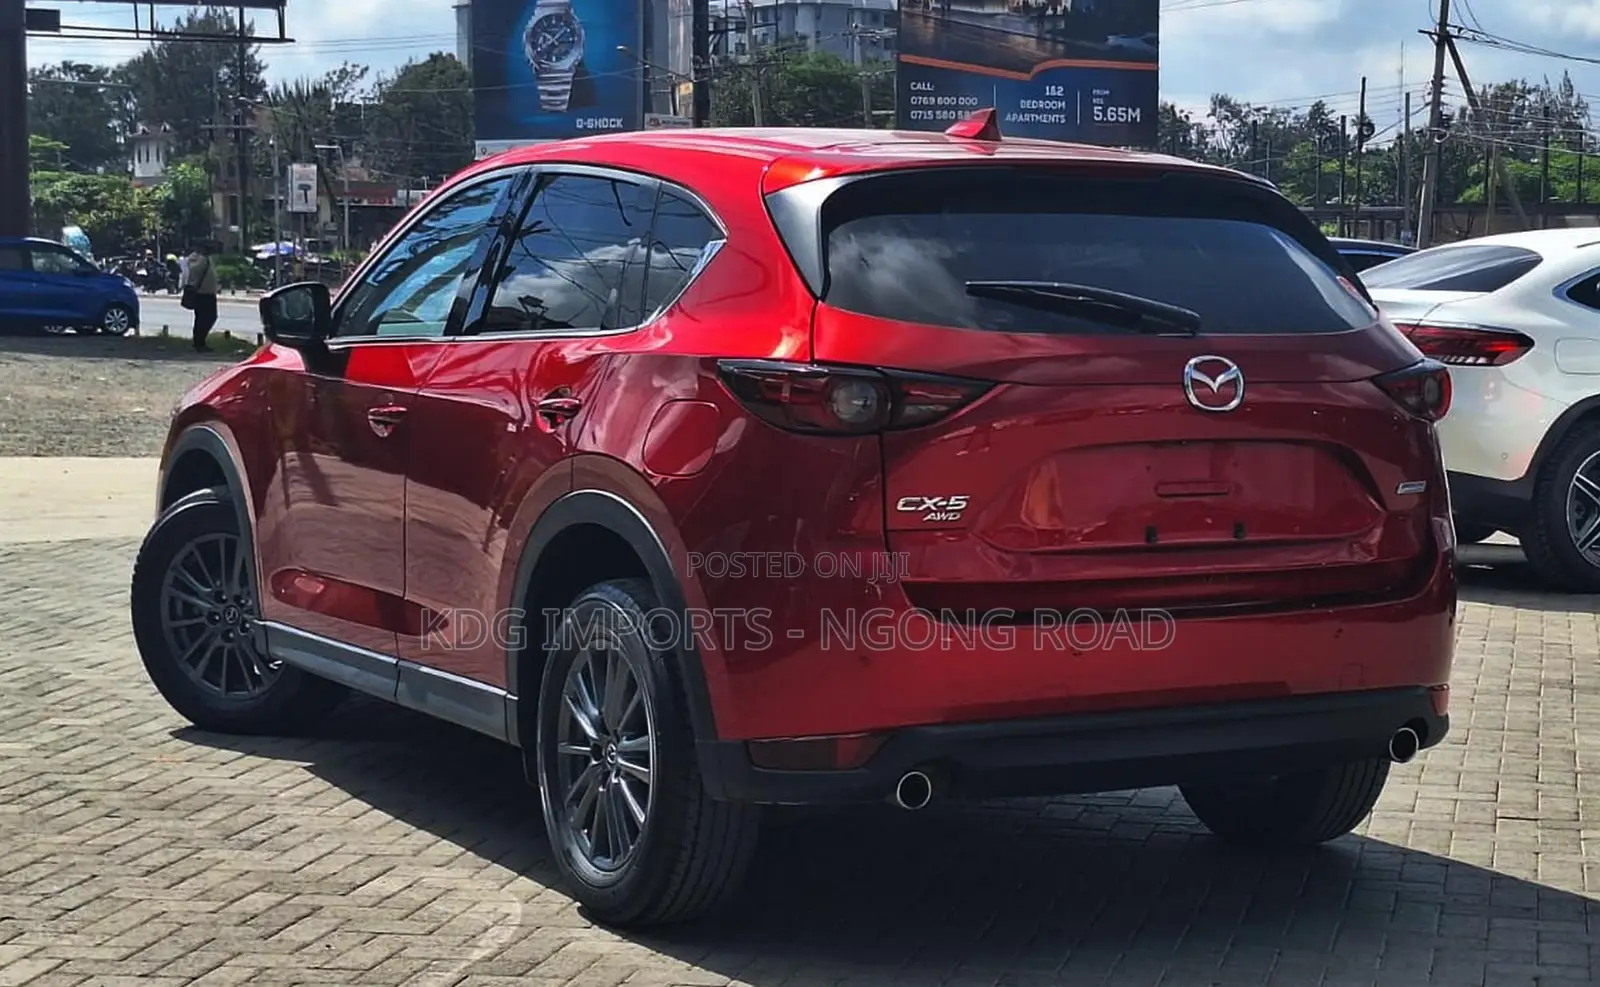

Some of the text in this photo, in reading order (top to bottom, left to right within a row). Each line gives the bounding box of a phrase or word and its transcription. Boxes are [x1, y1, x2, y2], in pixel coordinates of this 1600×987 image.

[910, 81, 934, 91] CALL:
[958, 96, 979, 106] 000
[1020, 99, 1066, 110] BEDROOM
[910, 110, 934, 119] 0715
[1005, 111, 1066, 123] APARTMENTS
[1093, 106, 1141, 123] 5.65M
[576, 117, 624, 129] G-SHOCK
[897, 495, 970, 511] CX-5
[923, 511, 961, 521] AWD
